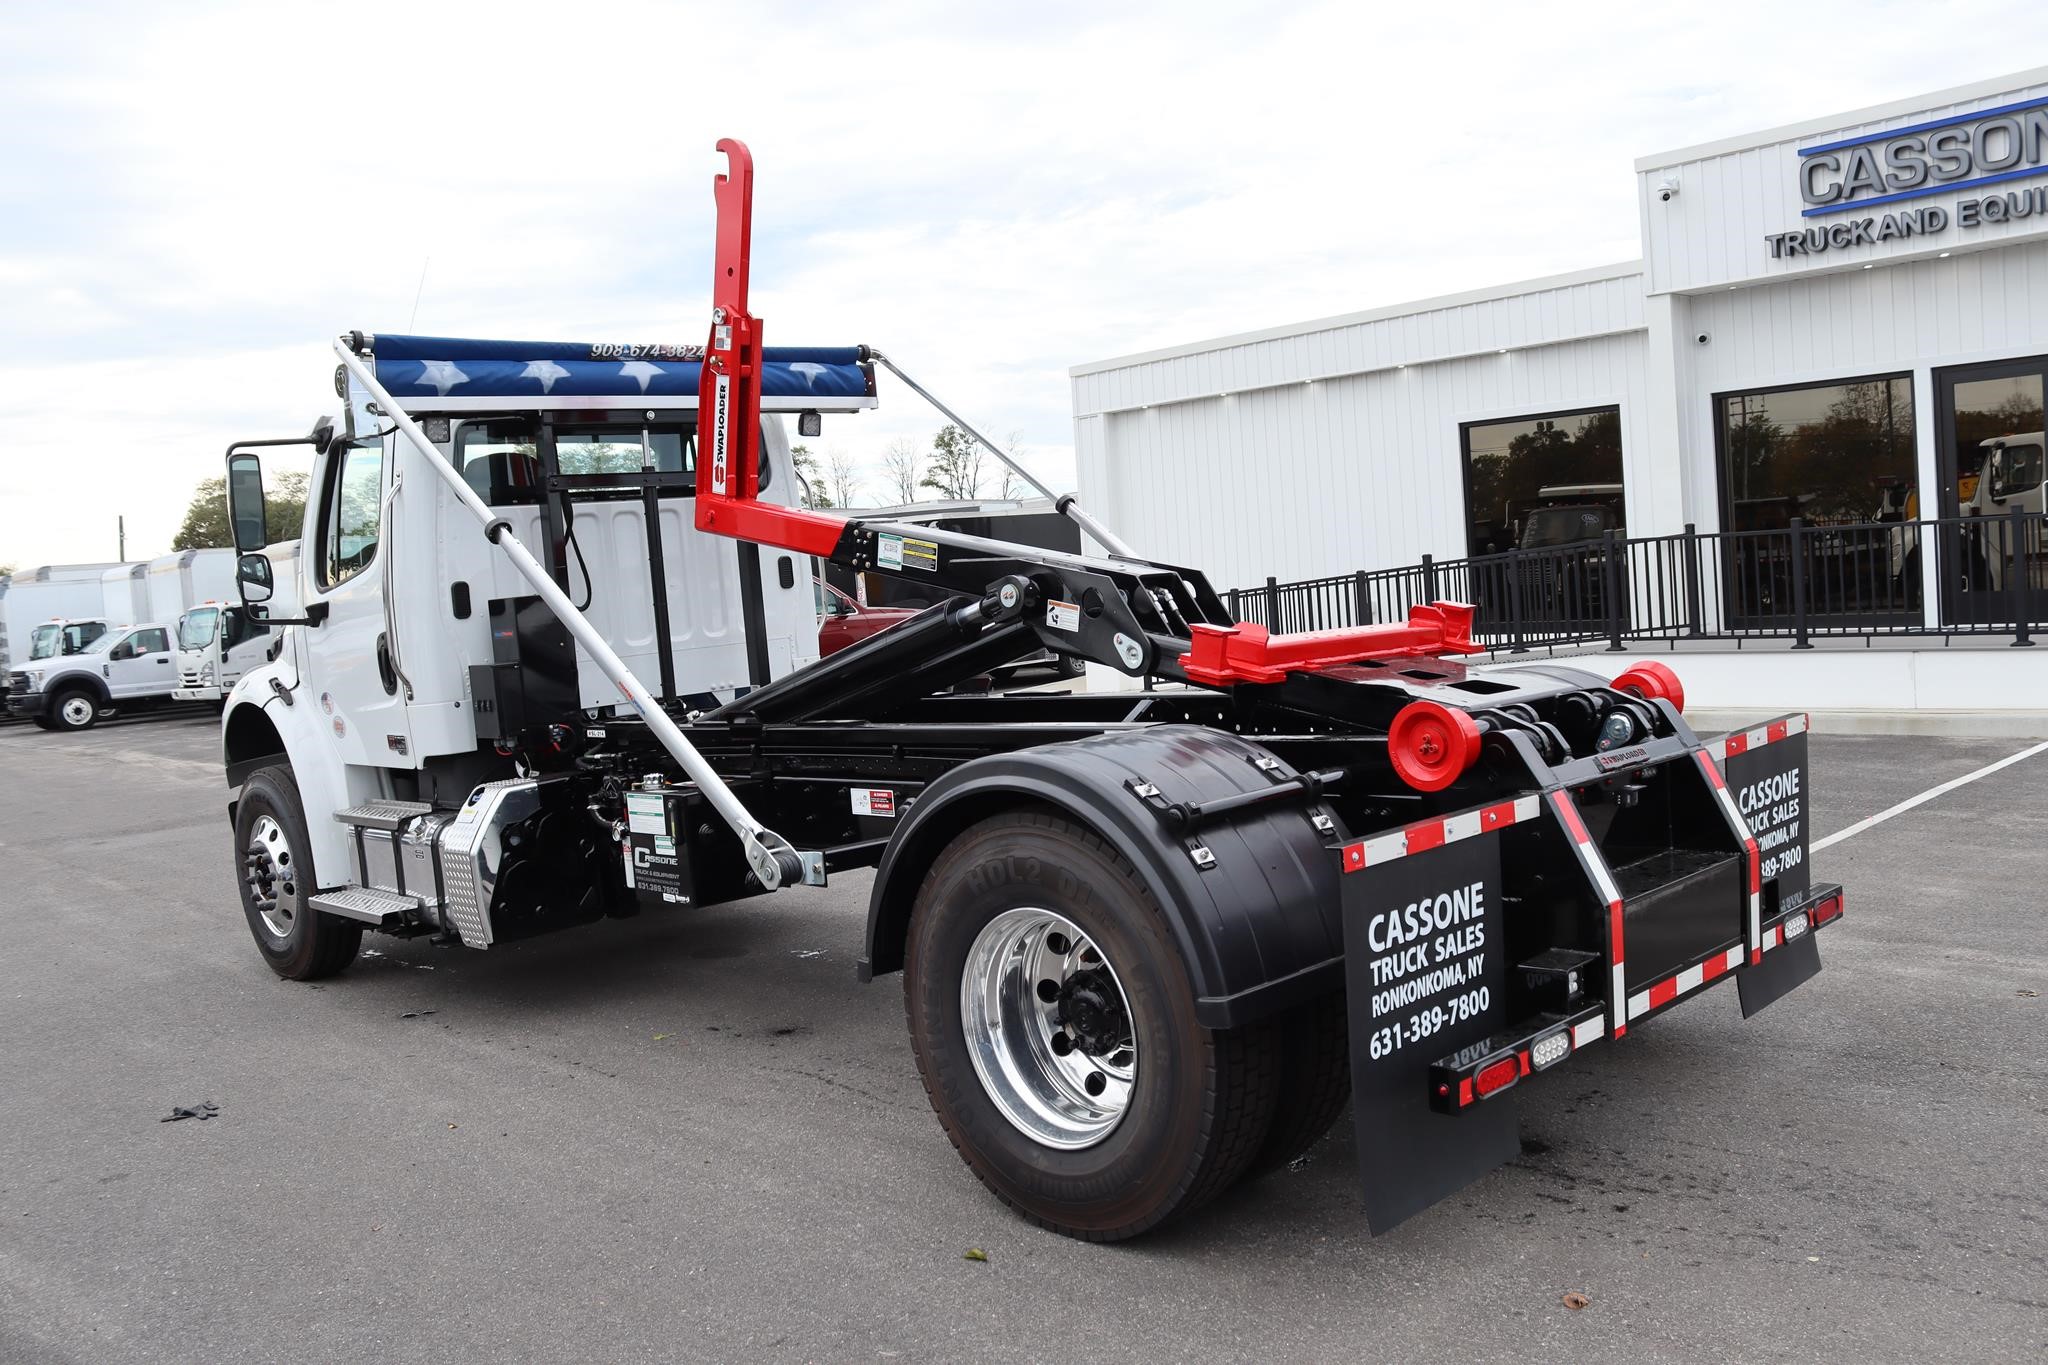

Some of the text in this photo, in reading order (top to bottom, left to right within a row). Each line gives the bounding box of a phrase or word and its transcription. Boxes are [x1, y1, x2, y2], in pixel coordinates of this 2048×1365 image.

[1957, 186, 2048, 228] EQUI
[717, 384, 727, 463] SWAPLOADER
[1740, 768, 1799, 815] CASSONE
[1773, 799, 1799, 825] SALES
[1790, 821, 1799, 839] NY
[1368, 881, 1484, 953] CASSONE
[1370, 922, 1485, 987] TRUCK SALES
[1372, 953, 1485, 1018] RONKONKOMA, NY
[1370, 986, 1490, 1060] 631-389-7800
